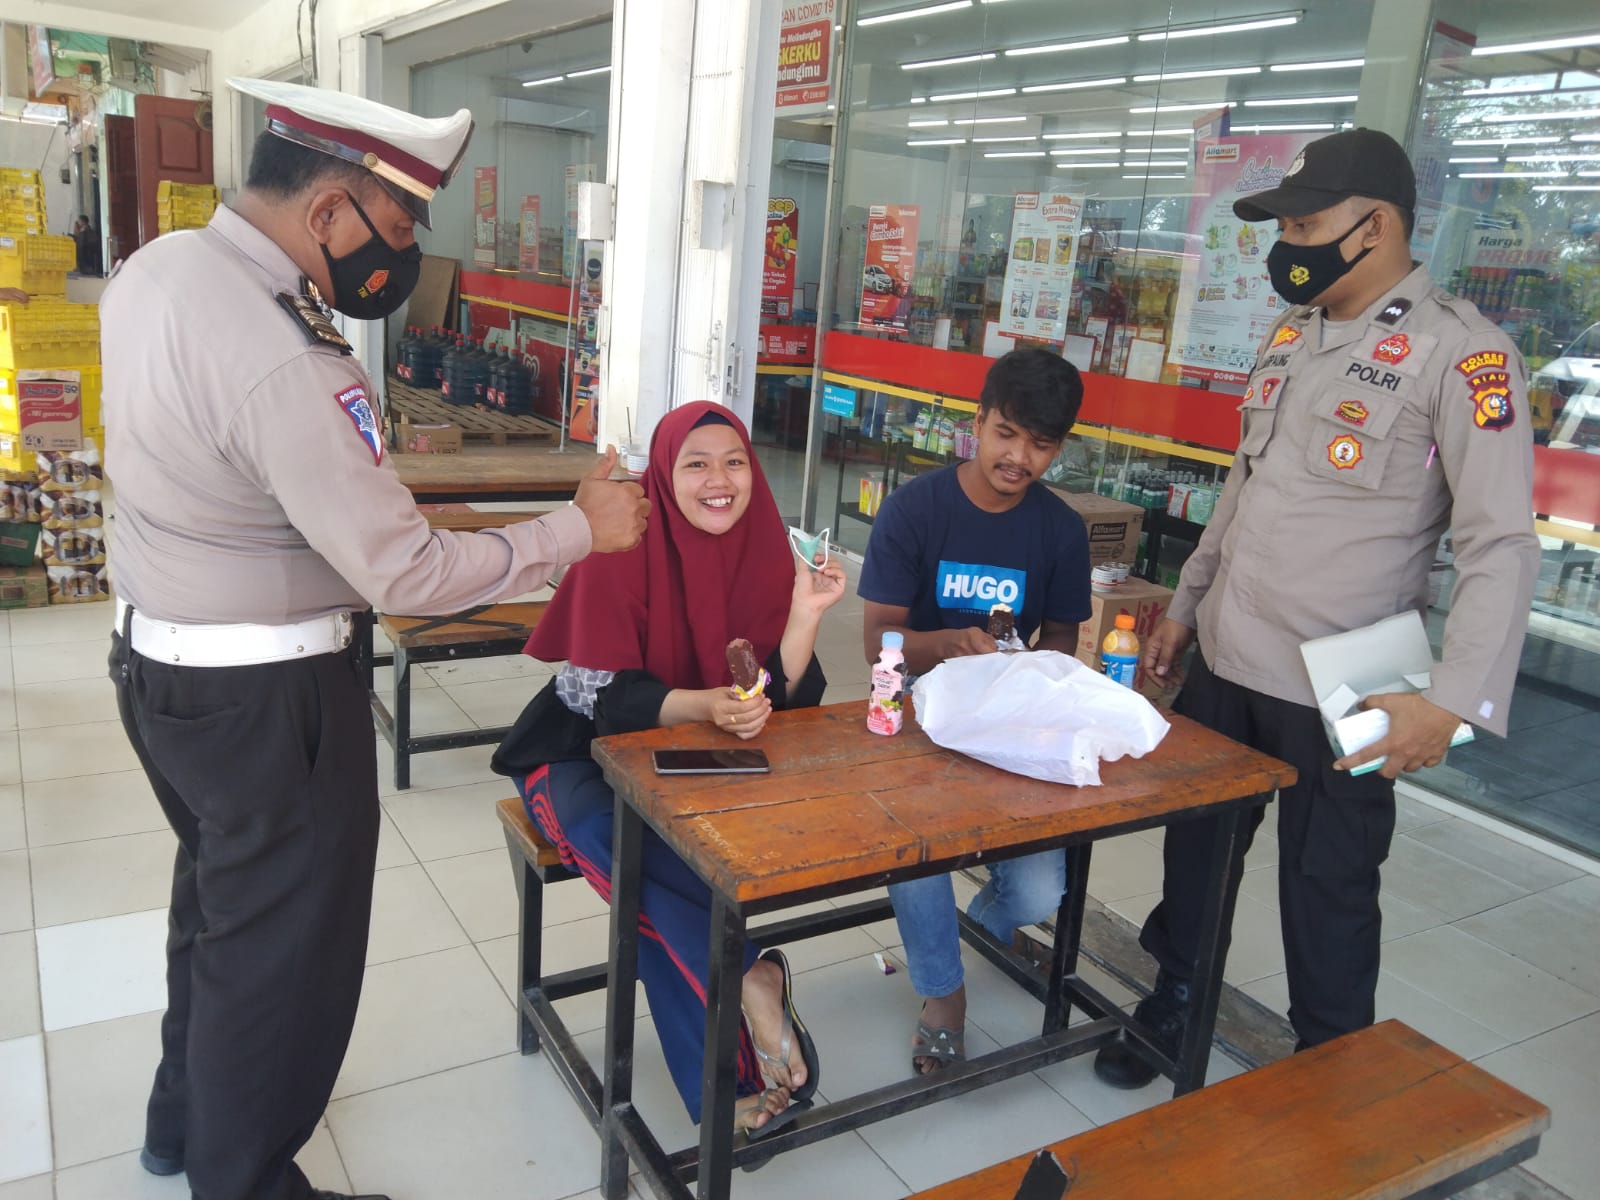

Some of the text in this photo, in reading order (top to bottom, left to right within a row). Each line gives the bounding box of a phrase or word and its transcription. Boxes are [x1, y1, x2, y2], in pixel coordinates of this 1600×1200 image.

[797, 3, 822, 20] COVID
[824, 0, 834, 13] 19
[1478, 236, 1523, 249] Harga
[1345, 362, 1402, 392] POLRI
[1472, 373, 1506, 387] RIAU
[942, 573, 1019, 604] HUGO
